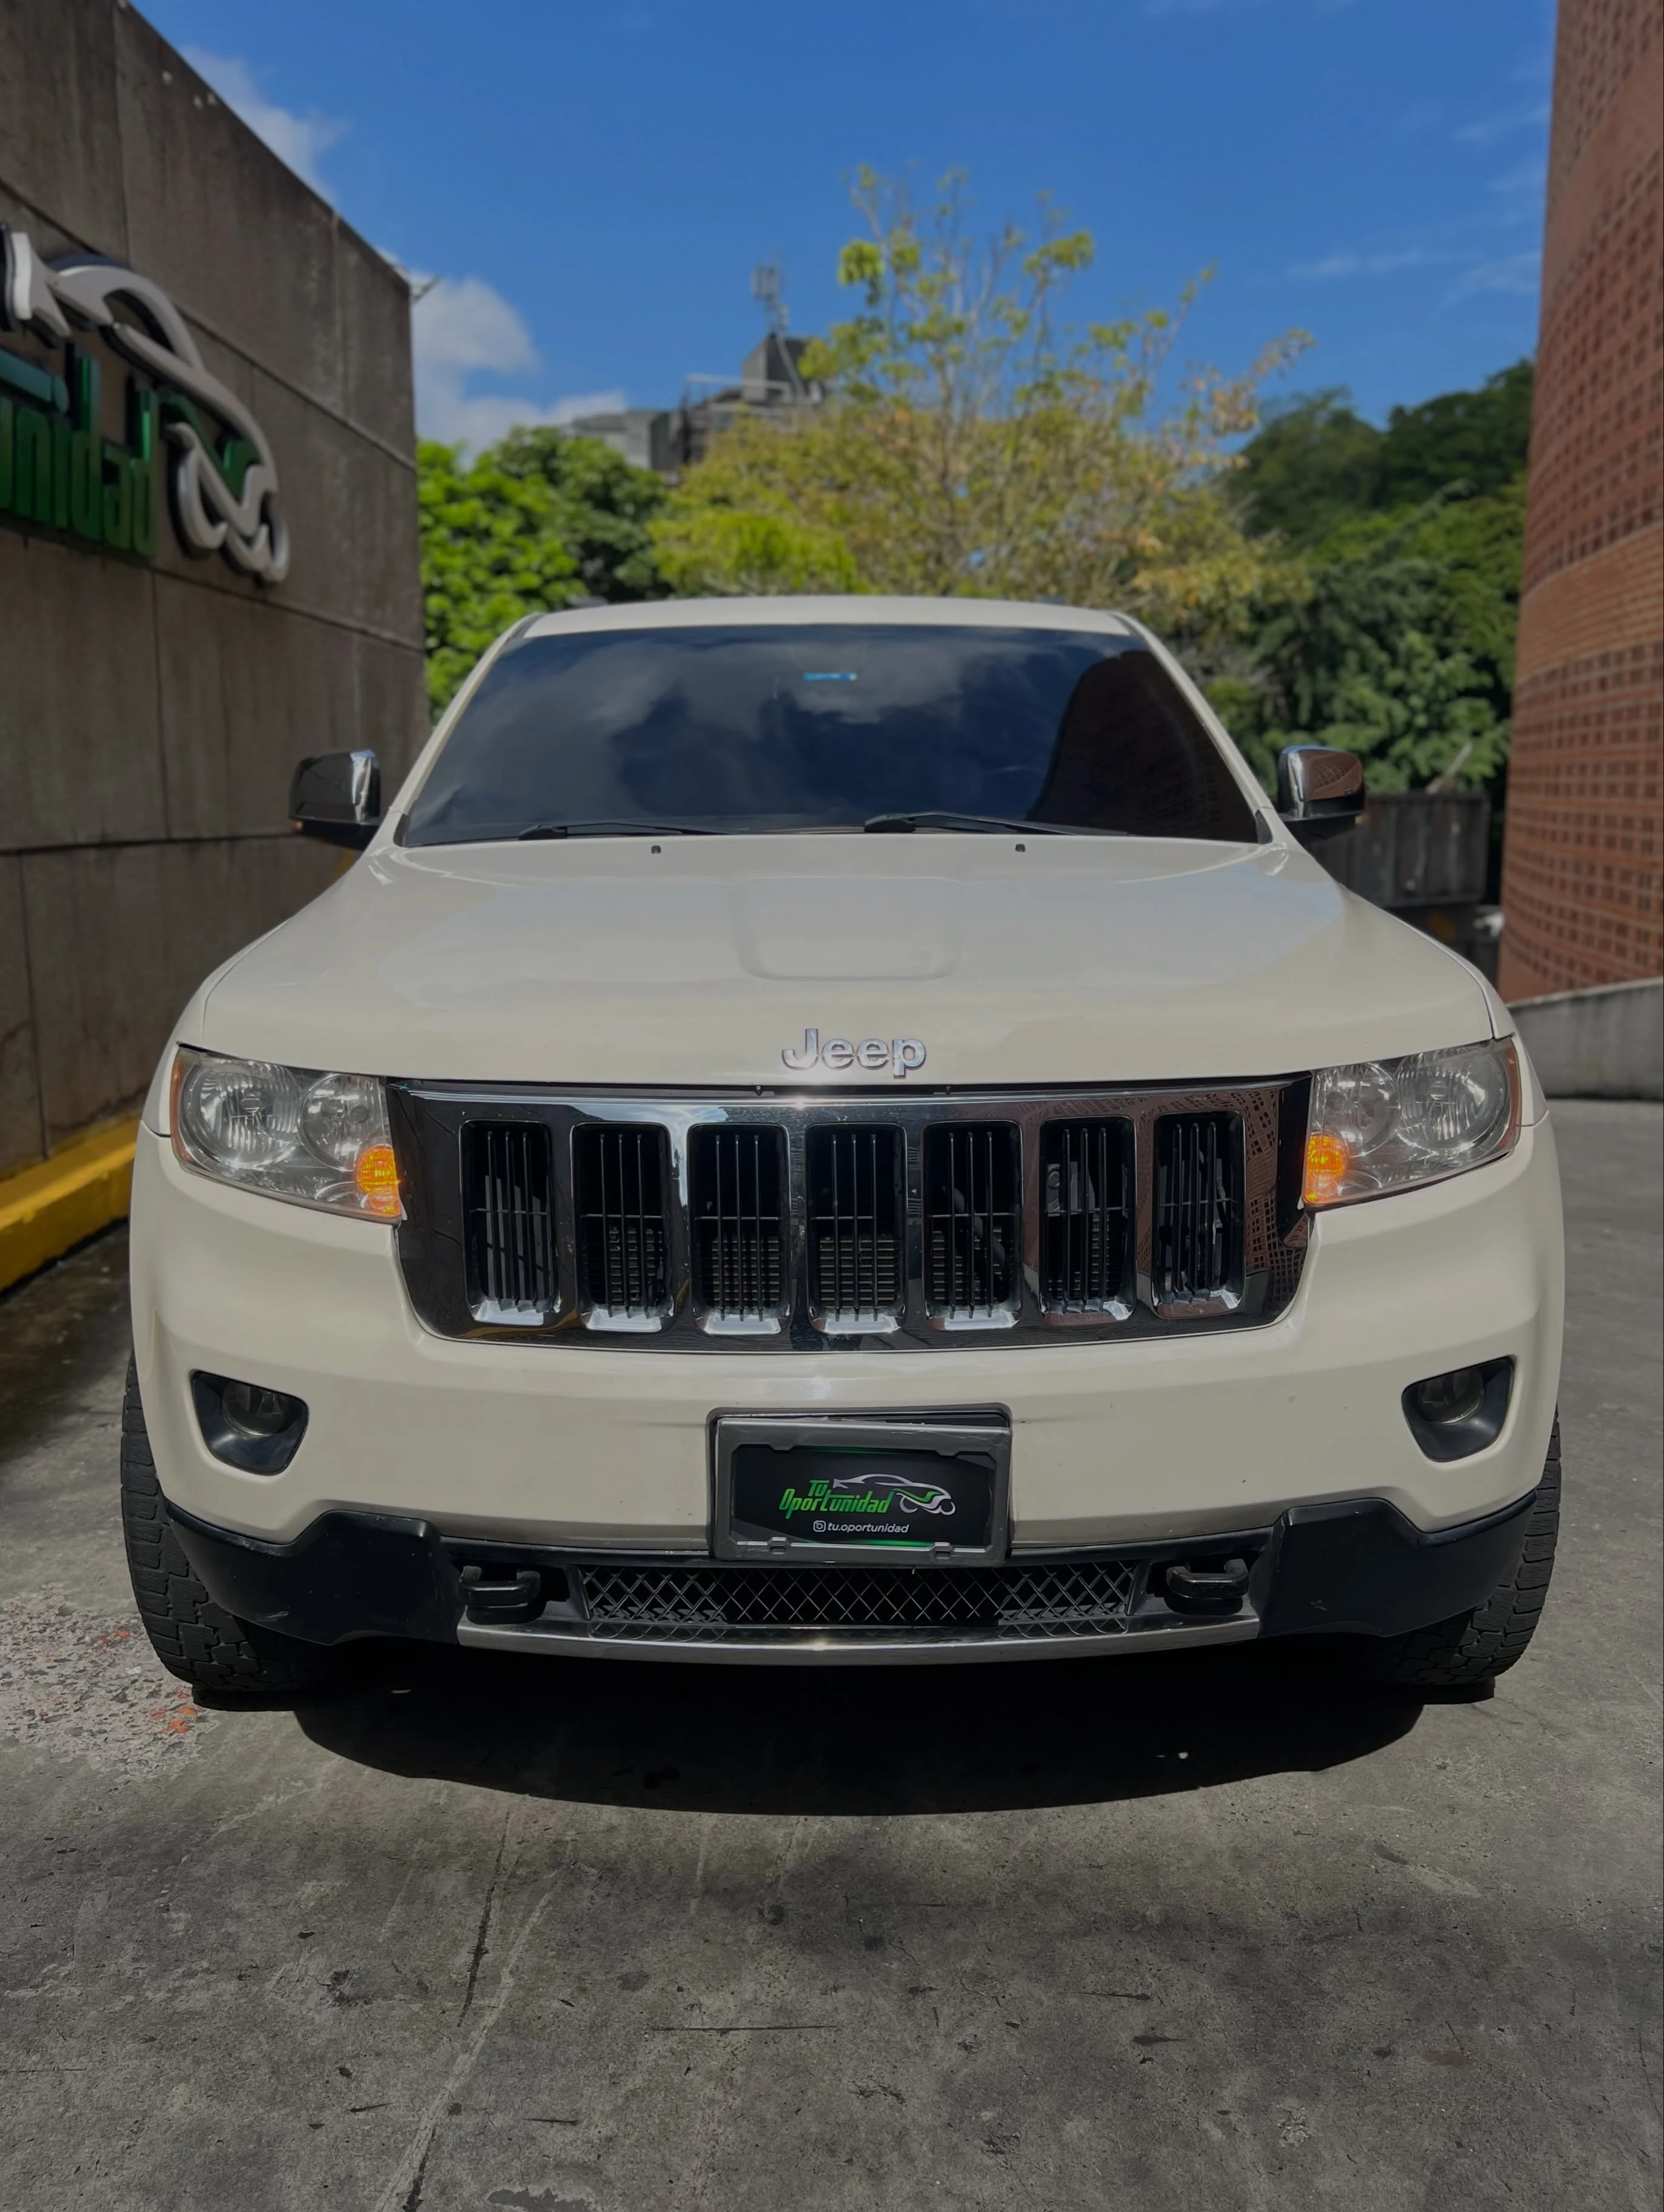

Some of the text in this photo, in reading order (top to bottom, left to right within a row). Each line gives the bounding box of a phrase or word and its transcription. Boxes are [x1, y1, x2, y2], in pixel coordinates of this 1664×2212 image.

[782, 1029, 926, 1079] Jeep
[808, 1480, 830, 1497] Tu
[779, 1489, 894, 1519] Oportunidad
[827, 1522, 910, 1533] tu.oportunidad
